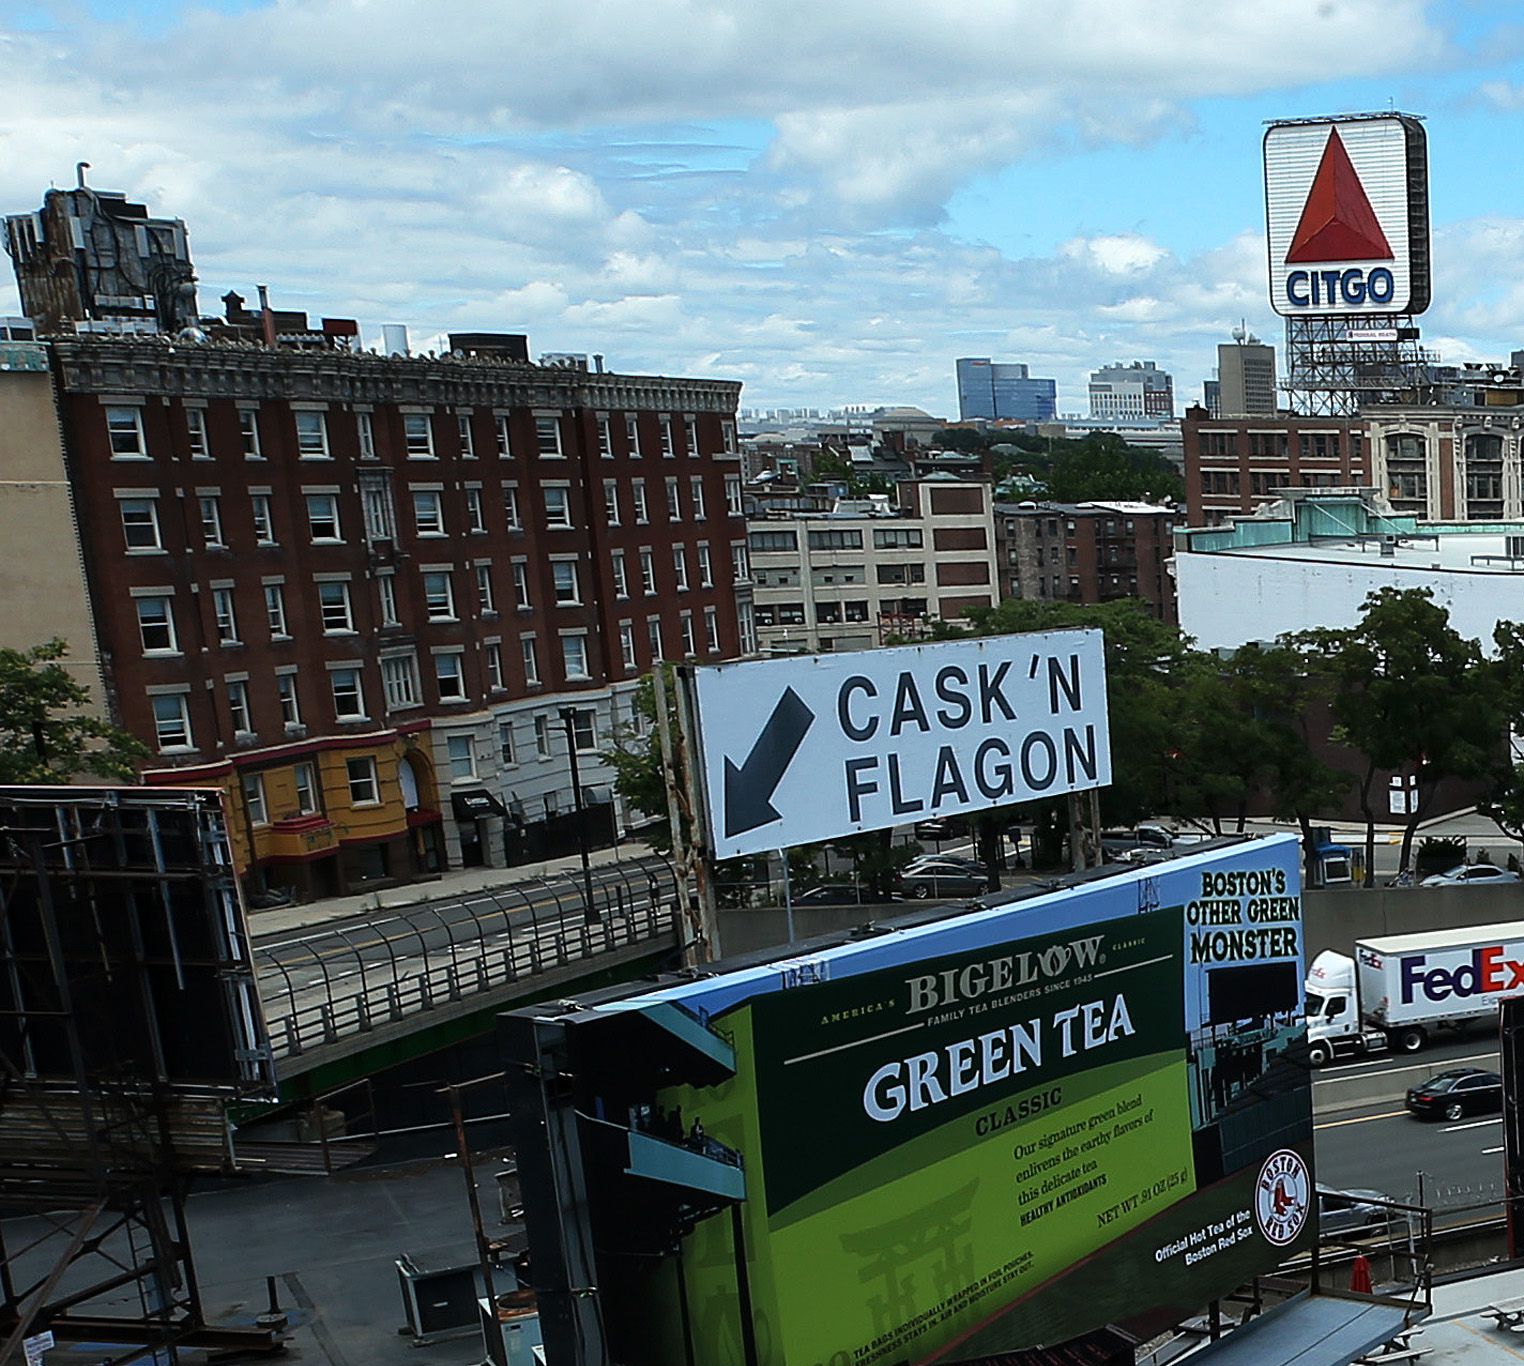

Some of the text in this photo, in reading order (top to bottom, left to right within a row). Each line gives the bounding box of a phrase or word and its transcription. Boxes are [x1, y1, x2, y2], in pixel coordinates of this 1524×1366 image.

[1286, 267, 1394, 306] CITGO
[845, 724, 1098, 822] FLAGON
[1201, 868, 1286, 897] BOSTON'S
[1187, 897, 1300, 926] OTHER GREEN
[1190, 927, 1299, 964] MONSTER
[820, 934, 1105, 1025] AMERICA'S BIGELOW
[926, 973, 1094, 1028] FAMILY TEA BLENDERS SINCE 1945
[863, 993, 1136, 1122] GREEN TEA
[975, 1087, 1063, 1137] CLASSIC
[1013, 1093, 1143, 1160] Our signature green blend
[1016, 1108, 1155, 1184] enlivens the earthy flavors of
[1017, 1160, 1098, 1206] this delicate tea
[1260, 1156, 1301, 1192] BOSTON
[1019, 1173, 1108, 1227] HEALTHY ANTIOXIDANTS
[1097, 1180, 1167, 1228] NET WT OZ
[1264, 1204, 1305, 1239] RED SOX
[1154, 1209, 1251, 1263] Official Hot Tea of the
[1184, 1225, 1253, 1266] Boston Red Sox
[853, 1300, 947, 1359] TEA BAGS INDIVIDUALLY
[903, 1325, 929, 1344] STAYS
